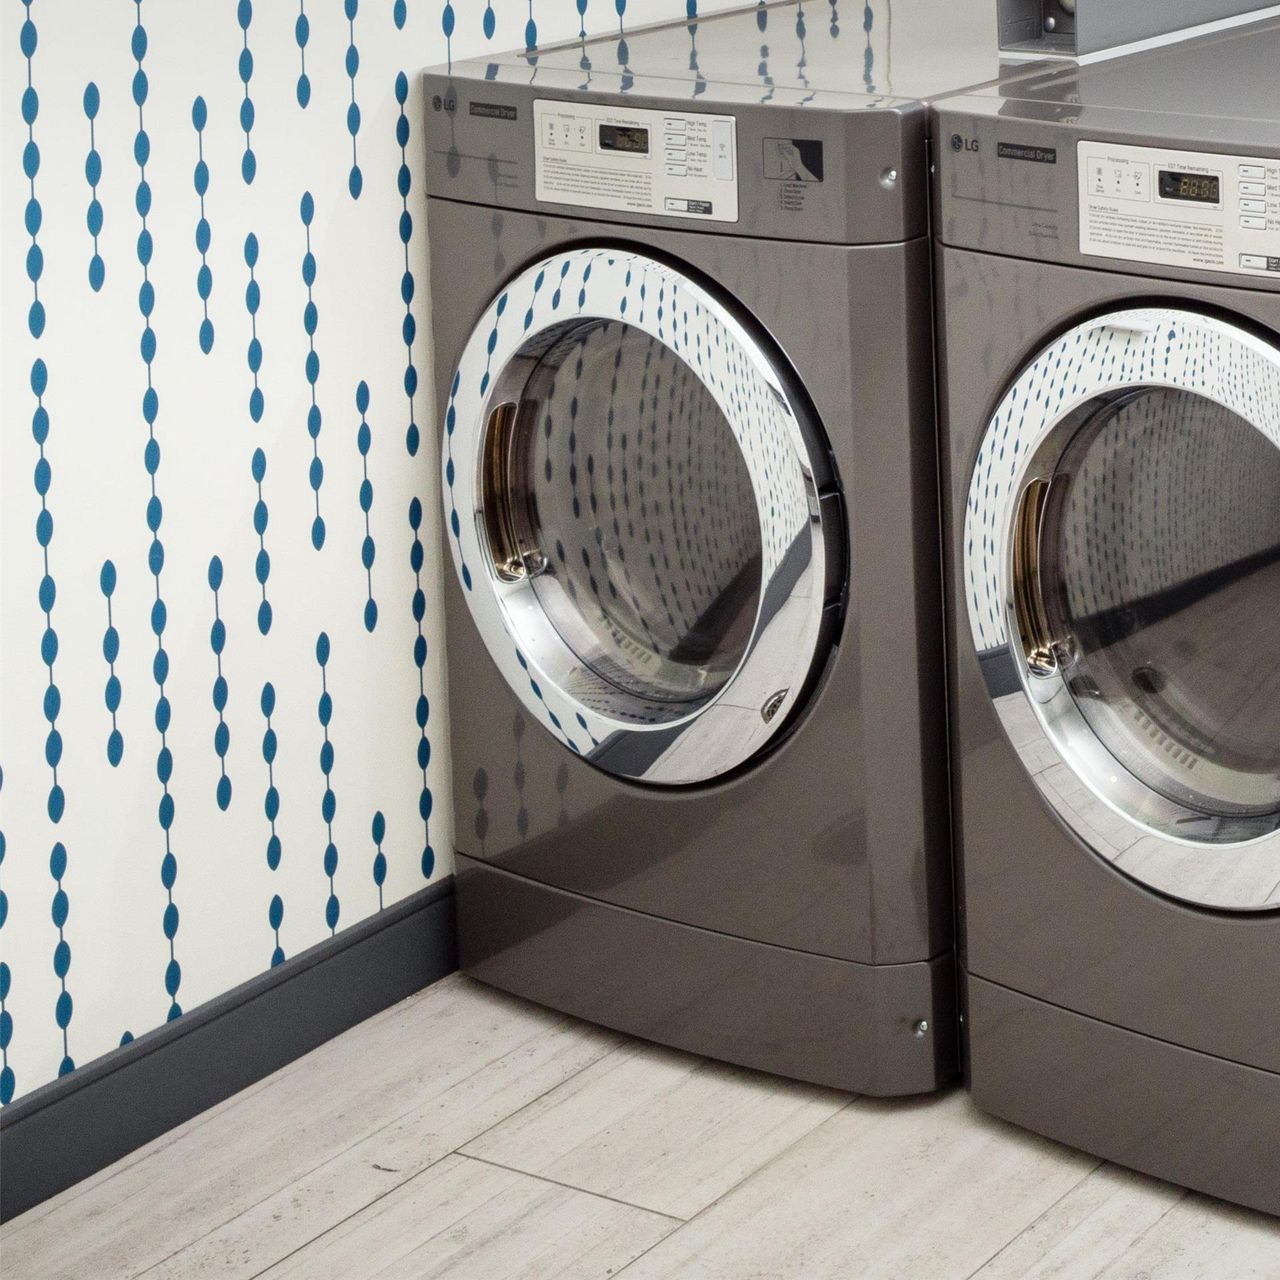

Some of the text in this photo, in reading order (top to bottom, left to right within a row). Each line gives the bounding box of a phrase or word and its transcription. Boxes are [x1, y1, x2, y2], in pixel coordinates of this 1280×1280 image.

[444, 99, 454, 111] LG
[965, 139, 979, 152] LG
[1036, 151, 1055, 160] Dryer
